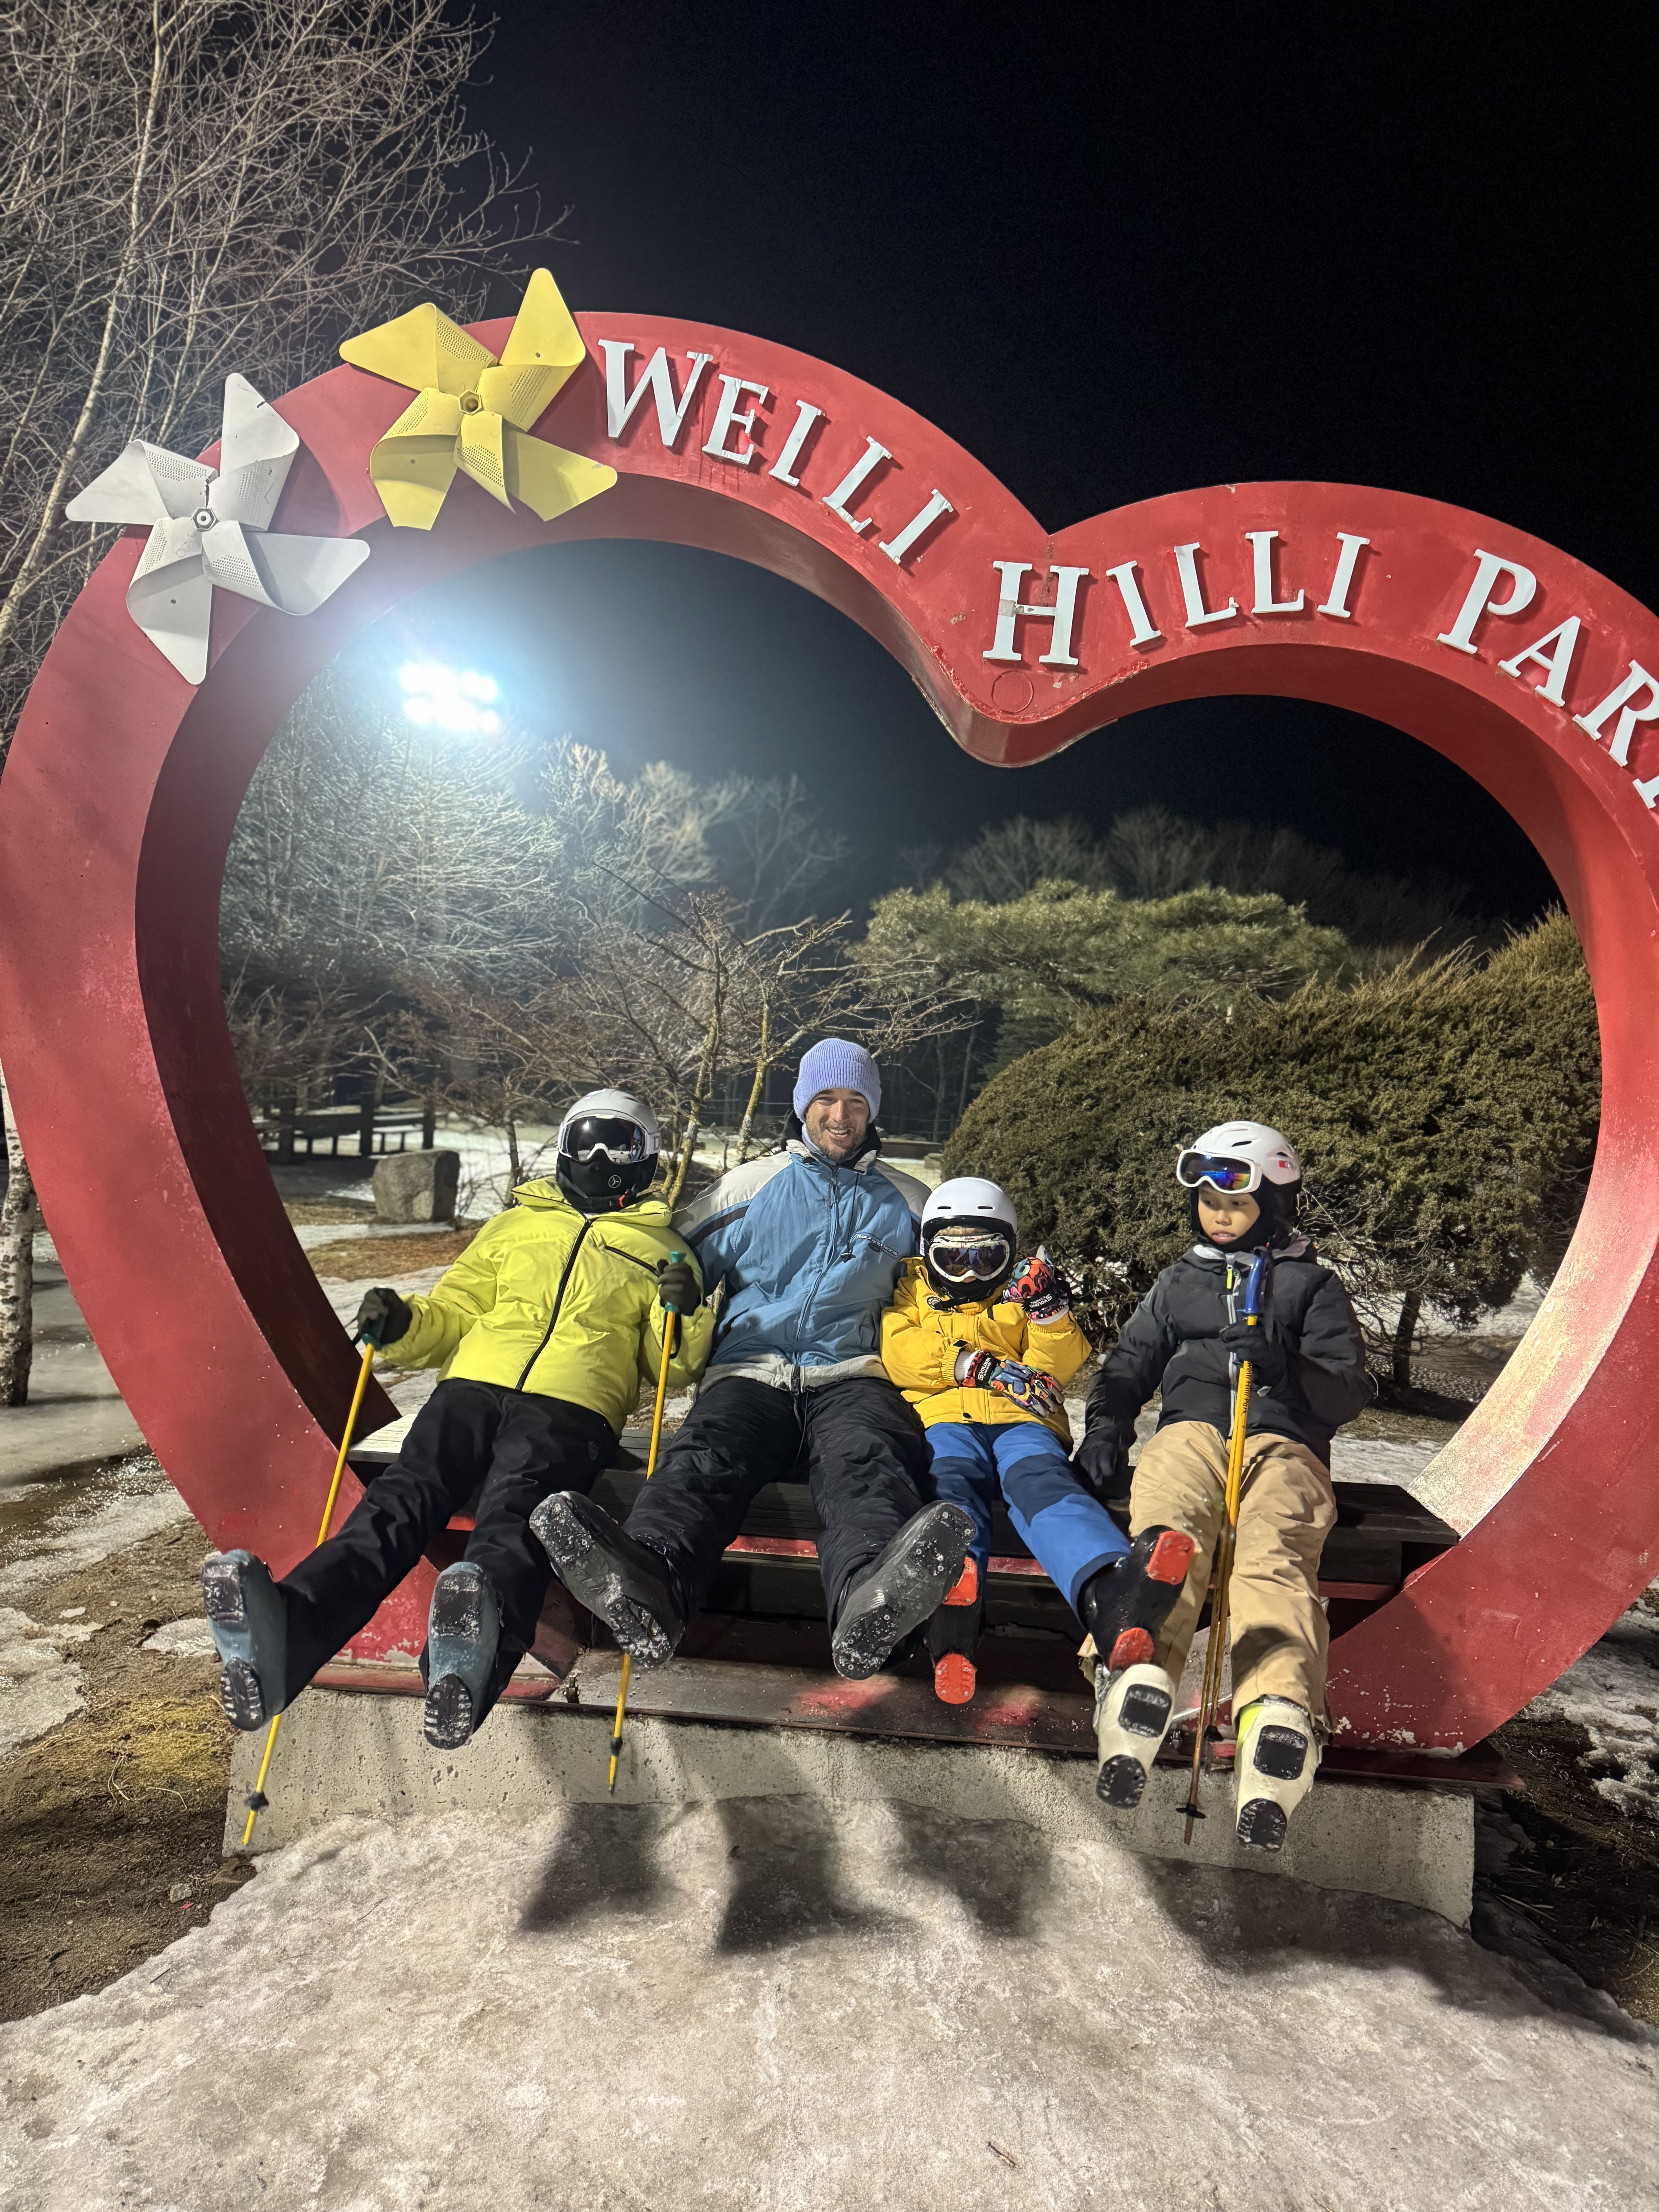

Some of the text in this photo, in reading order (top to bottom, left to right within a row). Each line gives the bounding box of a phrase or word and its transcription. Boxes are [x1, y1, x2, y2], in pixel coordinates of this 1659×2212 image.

[598, 339, 1659, 809] WELLI HILLI PAR
